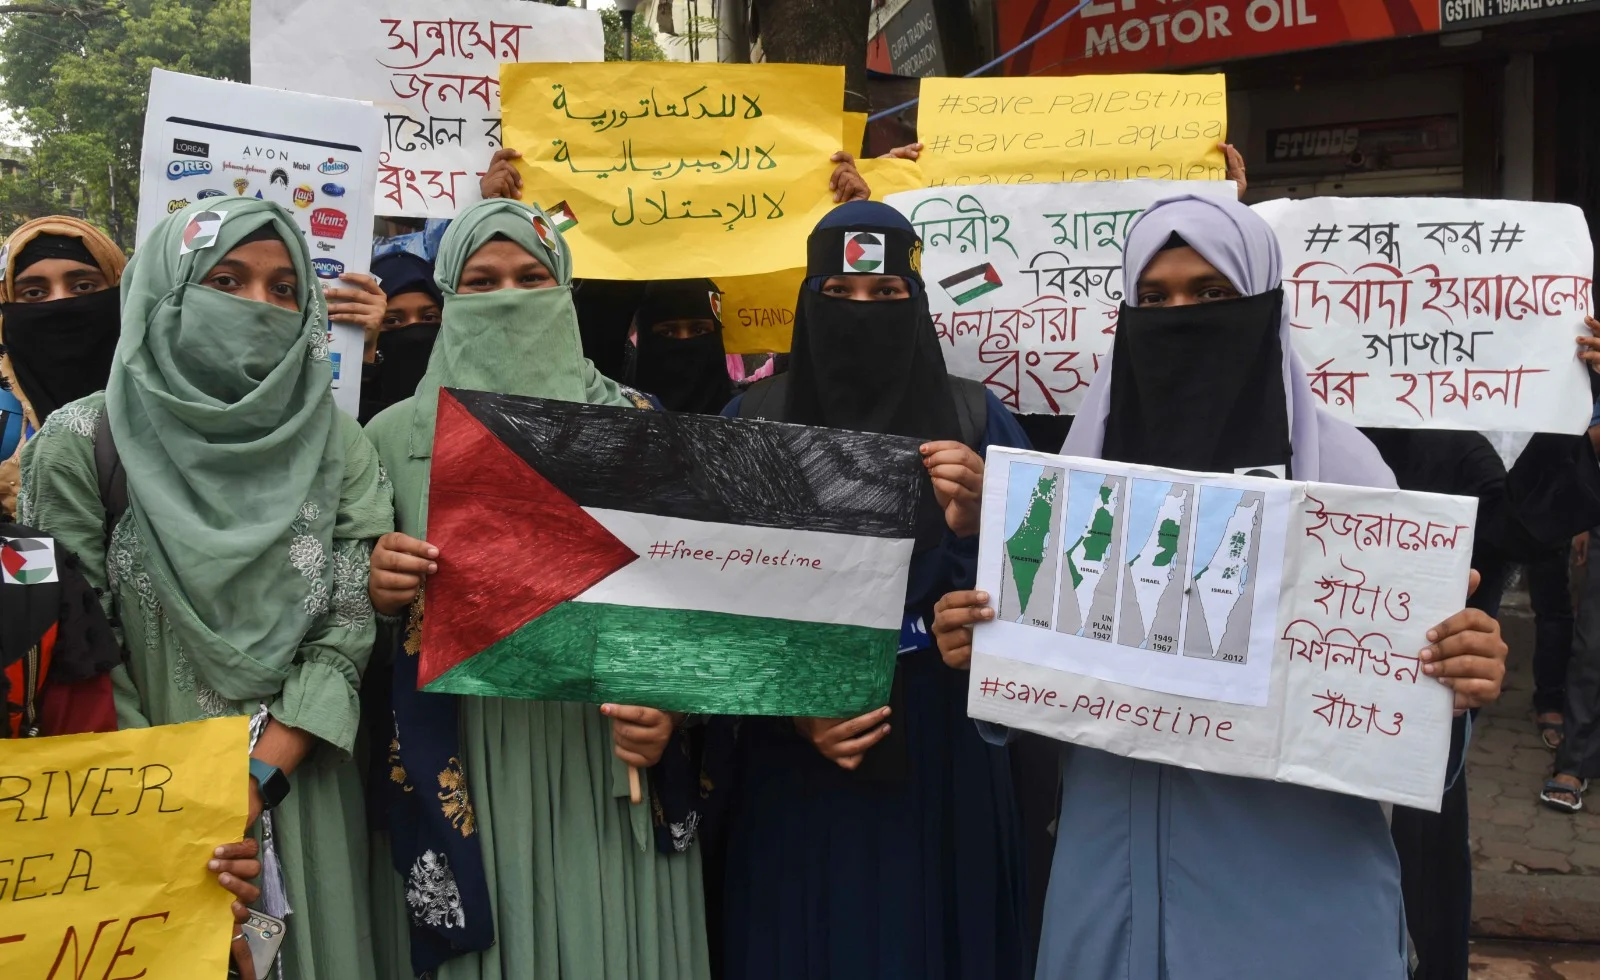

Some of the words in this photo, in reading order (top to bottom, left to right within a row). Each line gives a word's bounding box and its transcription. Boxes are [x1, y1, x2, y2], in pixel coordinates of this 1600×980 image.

[1445, 0, 1485, 22] GSTIN
[906, 12, 933, 46] TRADING
[1084, 5, 1233, 58] MOTOR
[1245, 0, 1317, 33] OIL
[741, 93, 764, 120] لا
[1274, 128, 1360, 159] STUDDS
[242, 145, 289, 161] AVON
[754, 140, 778, 171] لا
[168, 160, 212, 178] OREO
[292, 161, 311, 171] Mobil
[322, 161, 347, 172] Hostess
[765, 190, 787, 221] لا
[312, 212, 346, 227] Heinz
[737, 307, 795, 328] STAND
[1390, 365, 1551, 421] হামলা
[1011, 554, 1041, 565] PALESTINE
[1080, 566, 1100, 575] ISRAEL
[1140, 577, 1161, 586] ISRAEL
[1211, 587, 1233, 595] ISRAEL
[1031, 618, 1049, 628] 1946
[1101, 614, 1112, 622] UN
[1092, 621, 1112, 631] PLAN
[1092, 631, 1111, 641] 1947
[1153, 633, 1173, 643] 1949
[1152, 642, 1172, 653] 1967
[1222, 653, 1244, 663] 2012
[0, 763, 184, 822] RIVER
